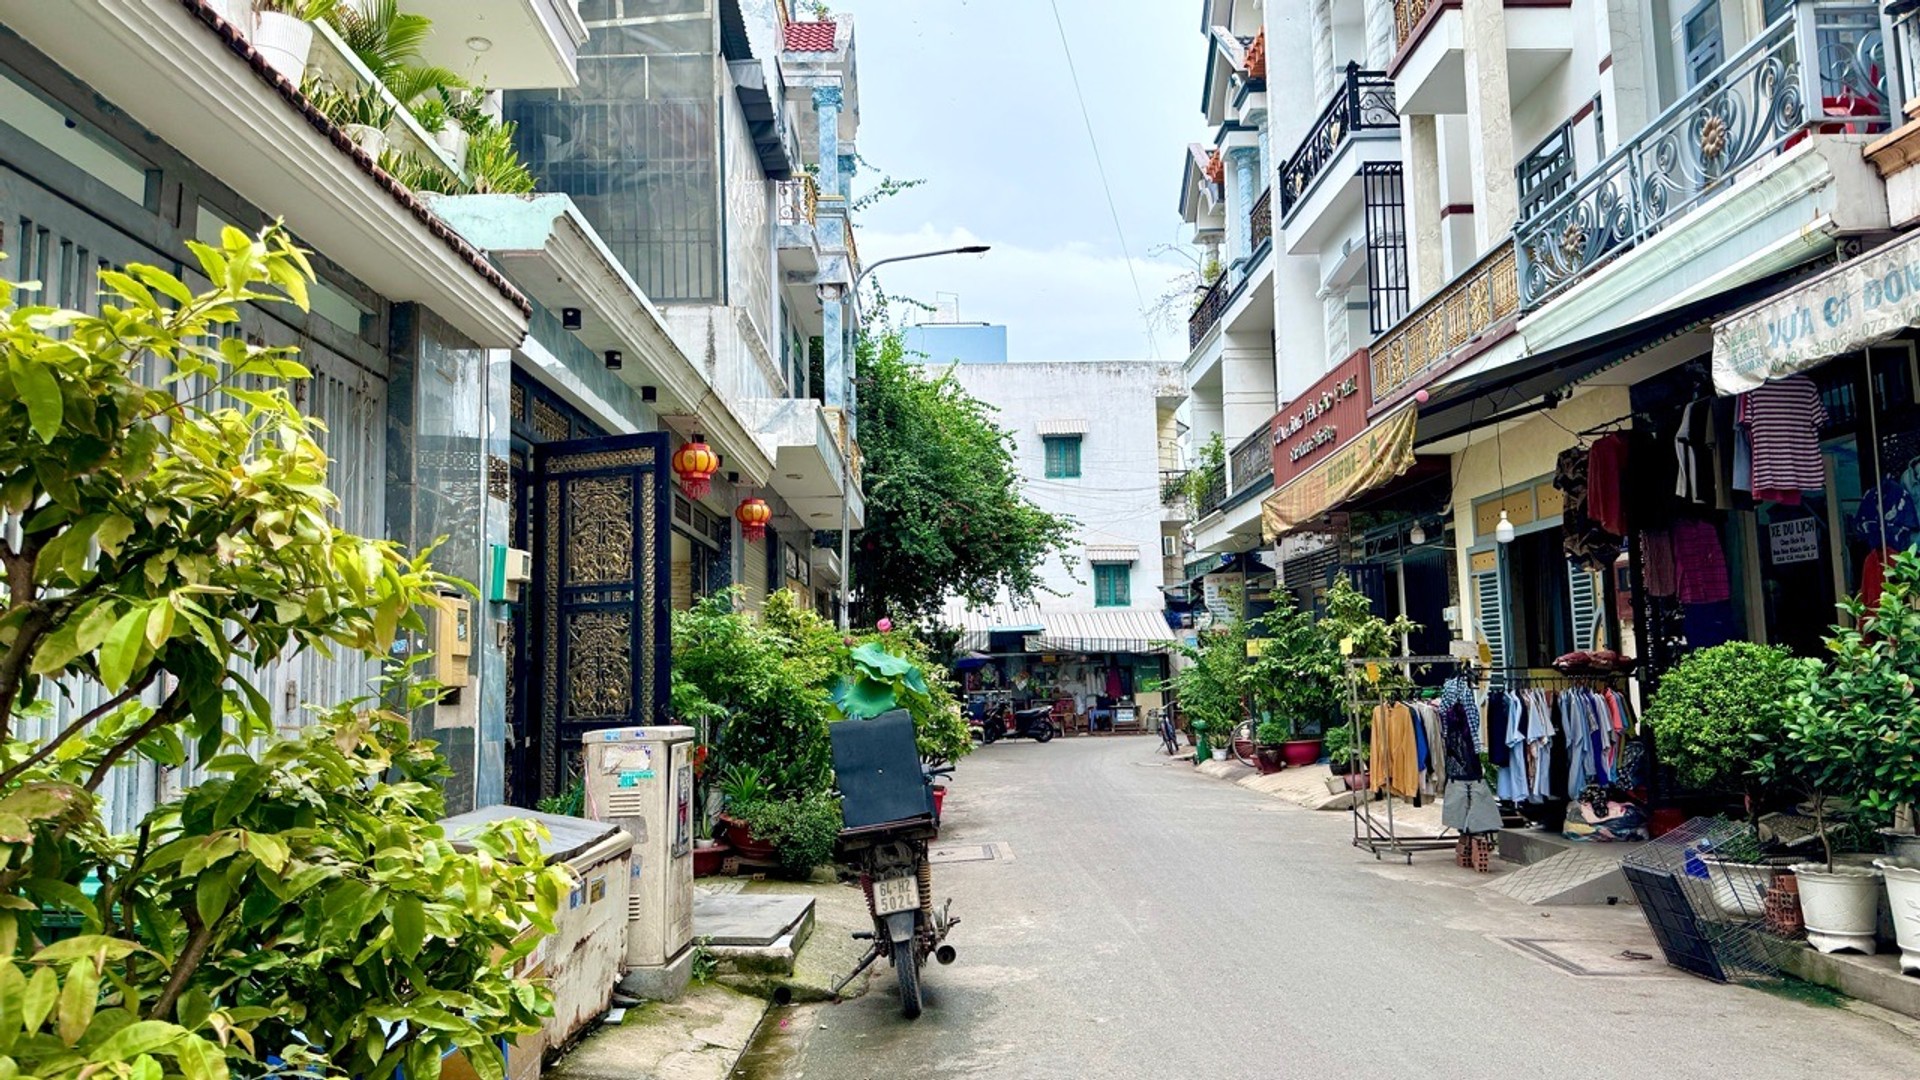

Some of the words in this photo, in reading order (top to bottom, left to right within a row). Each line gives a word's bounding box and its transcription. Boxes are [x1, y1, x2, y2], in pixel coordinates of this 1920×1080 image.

[1768, 306, 1815, 349] VỰA
[1771, 524, 1782, 537] XE
[1782, 522, 1795, 536] DU
[1795, 519, 1815, 537] LỊCH
[880, 880, 911, 897] 64-H2
[881, 893, 913, 912] 5024
